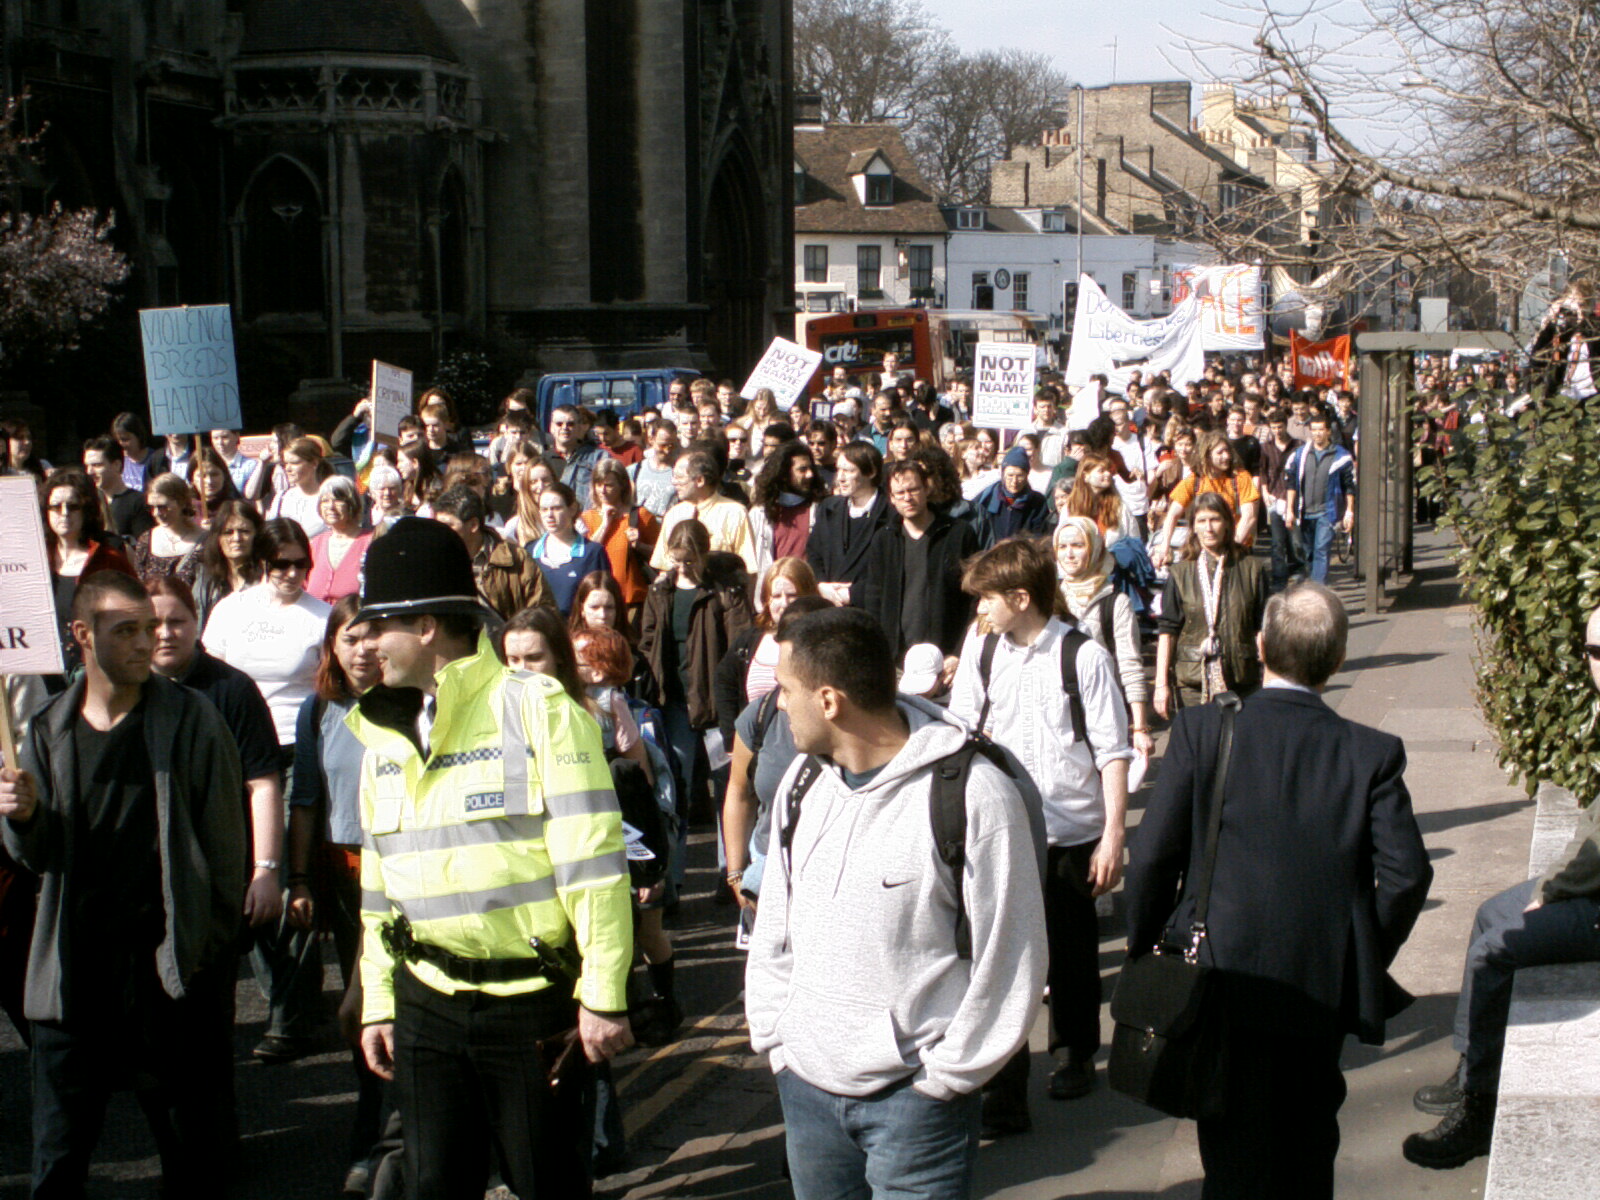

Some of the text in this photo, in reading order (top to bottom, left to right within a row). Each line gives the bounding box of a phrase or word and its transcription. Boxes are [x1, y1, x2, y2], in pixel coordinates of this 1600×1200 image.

[141, 308, 230, 346] VIOLENCE
[150, 346, 228, 380] BREEDS
[765, 358, 780, 368] IN
[770, 348, 813, 370] NOT
[981, 355, 1030, 371] NOT
[760, 365, 800, 386] NAME
[980, 370, 1028, 383] IN MY
[979, 382, 1030, 395] NAME
[151, 382, 239, 427] HATRED
[556, 752, 592, 765] POLICE
[465, 793, 503, 811] POLICE
